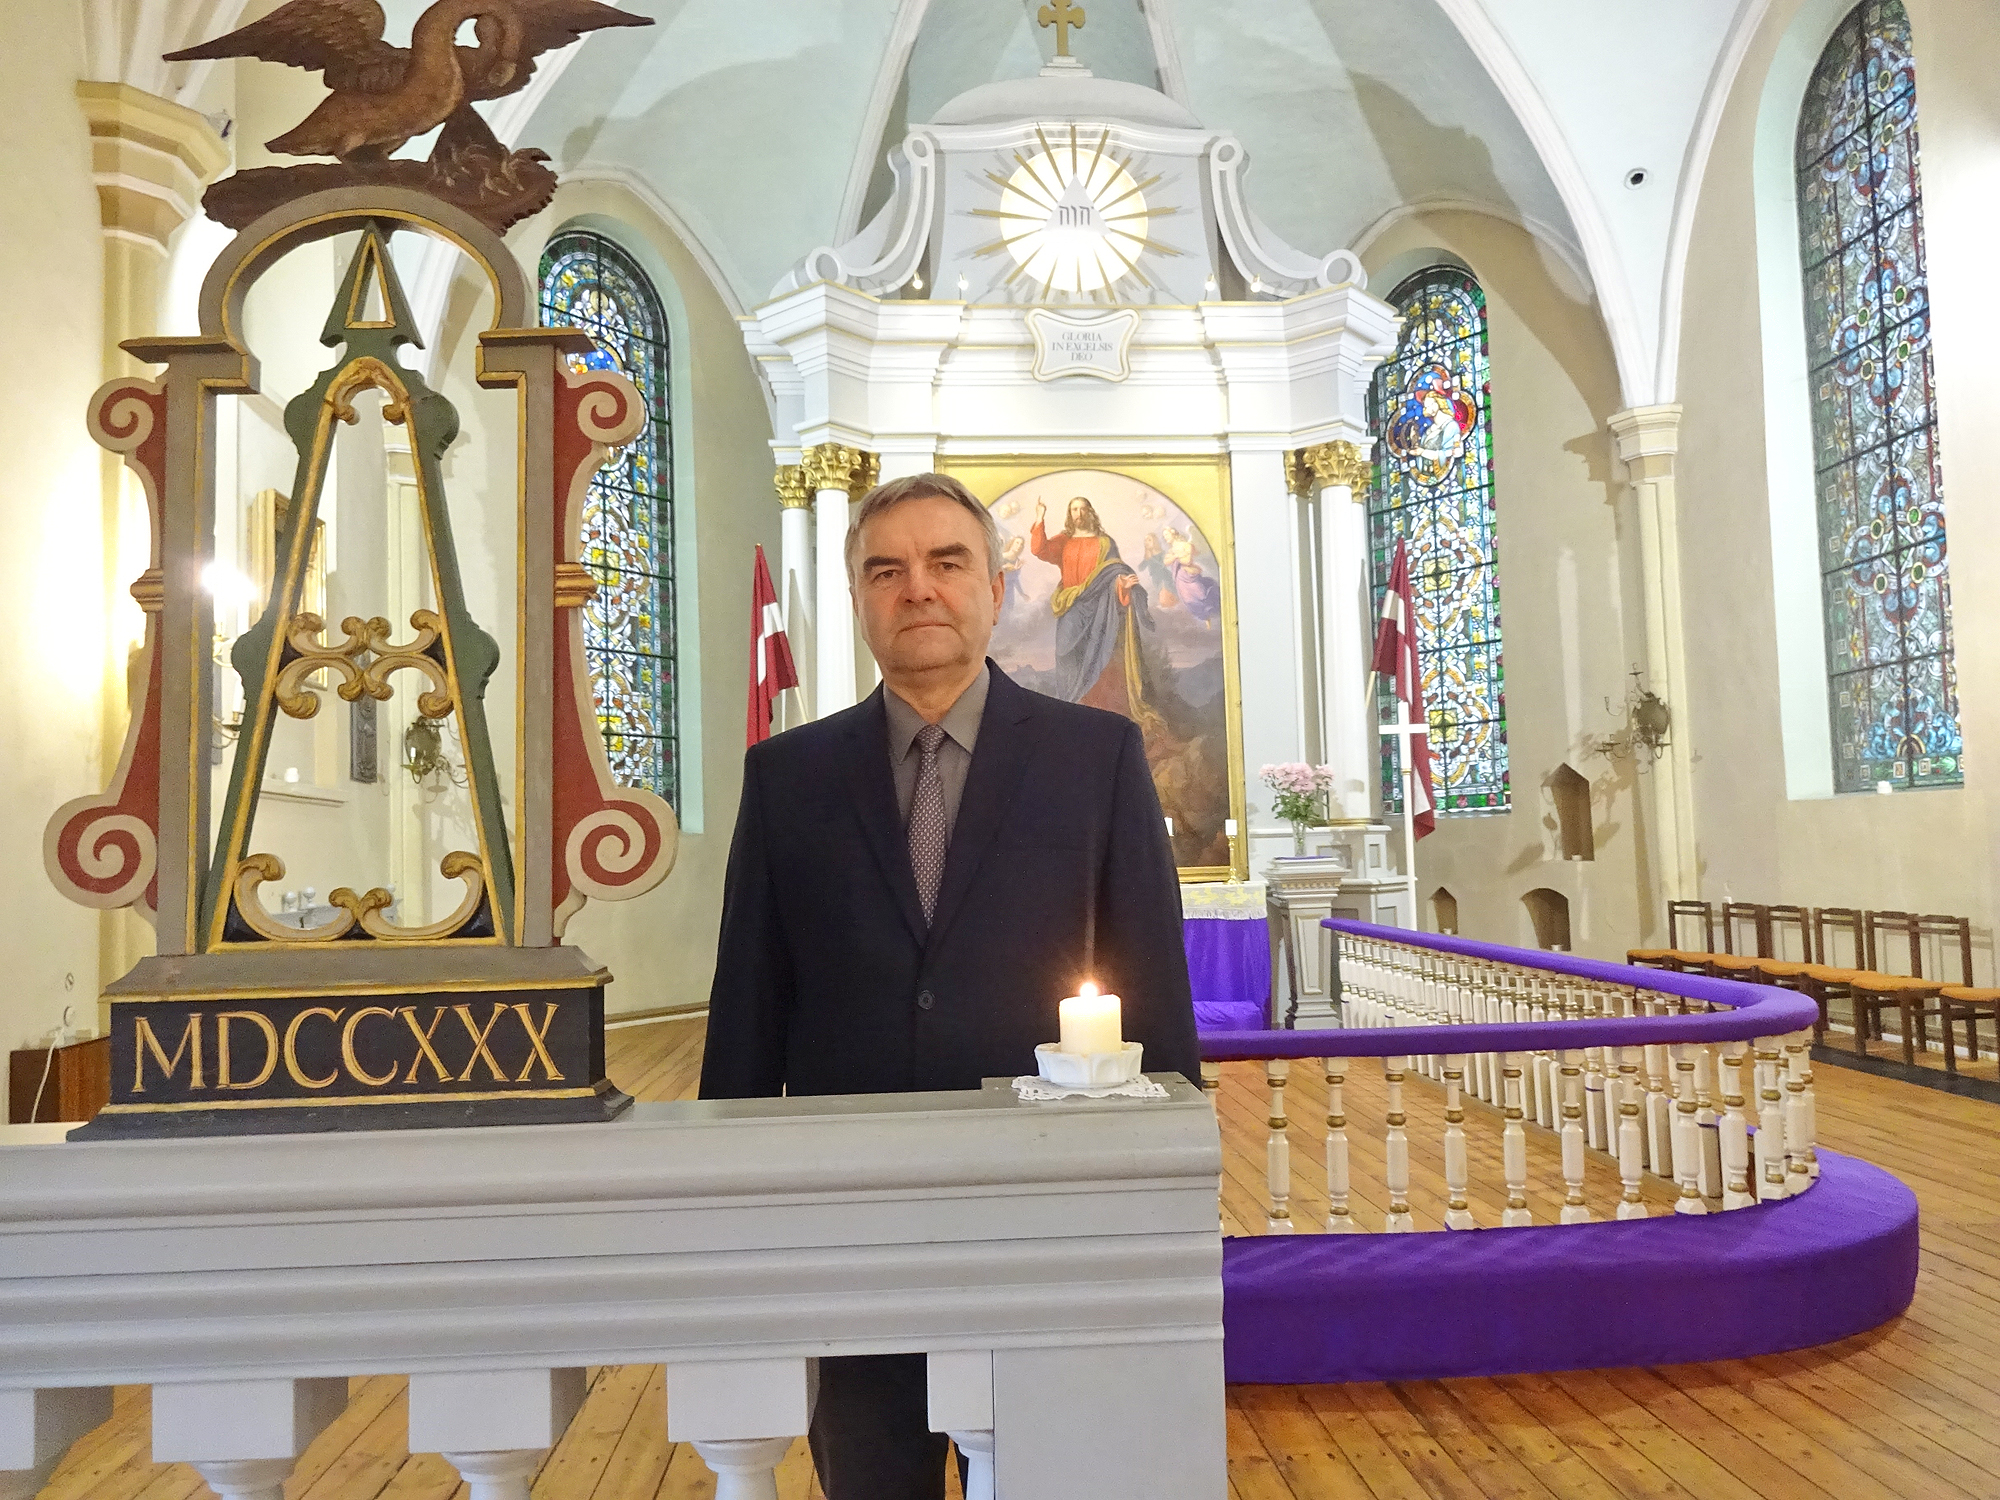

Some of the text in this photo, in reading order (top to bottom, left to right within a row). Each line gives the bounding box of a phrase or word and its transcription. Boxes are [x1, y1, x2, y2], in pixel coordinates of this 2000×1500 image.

[1062, 332, 1102, 341] GLORIA
[1052, 342, 1113, 351] IN EXCELSIS
[1071, 352, 1093, 361] DEO
[131, 1002, 565, 1093] MDCCXXX
